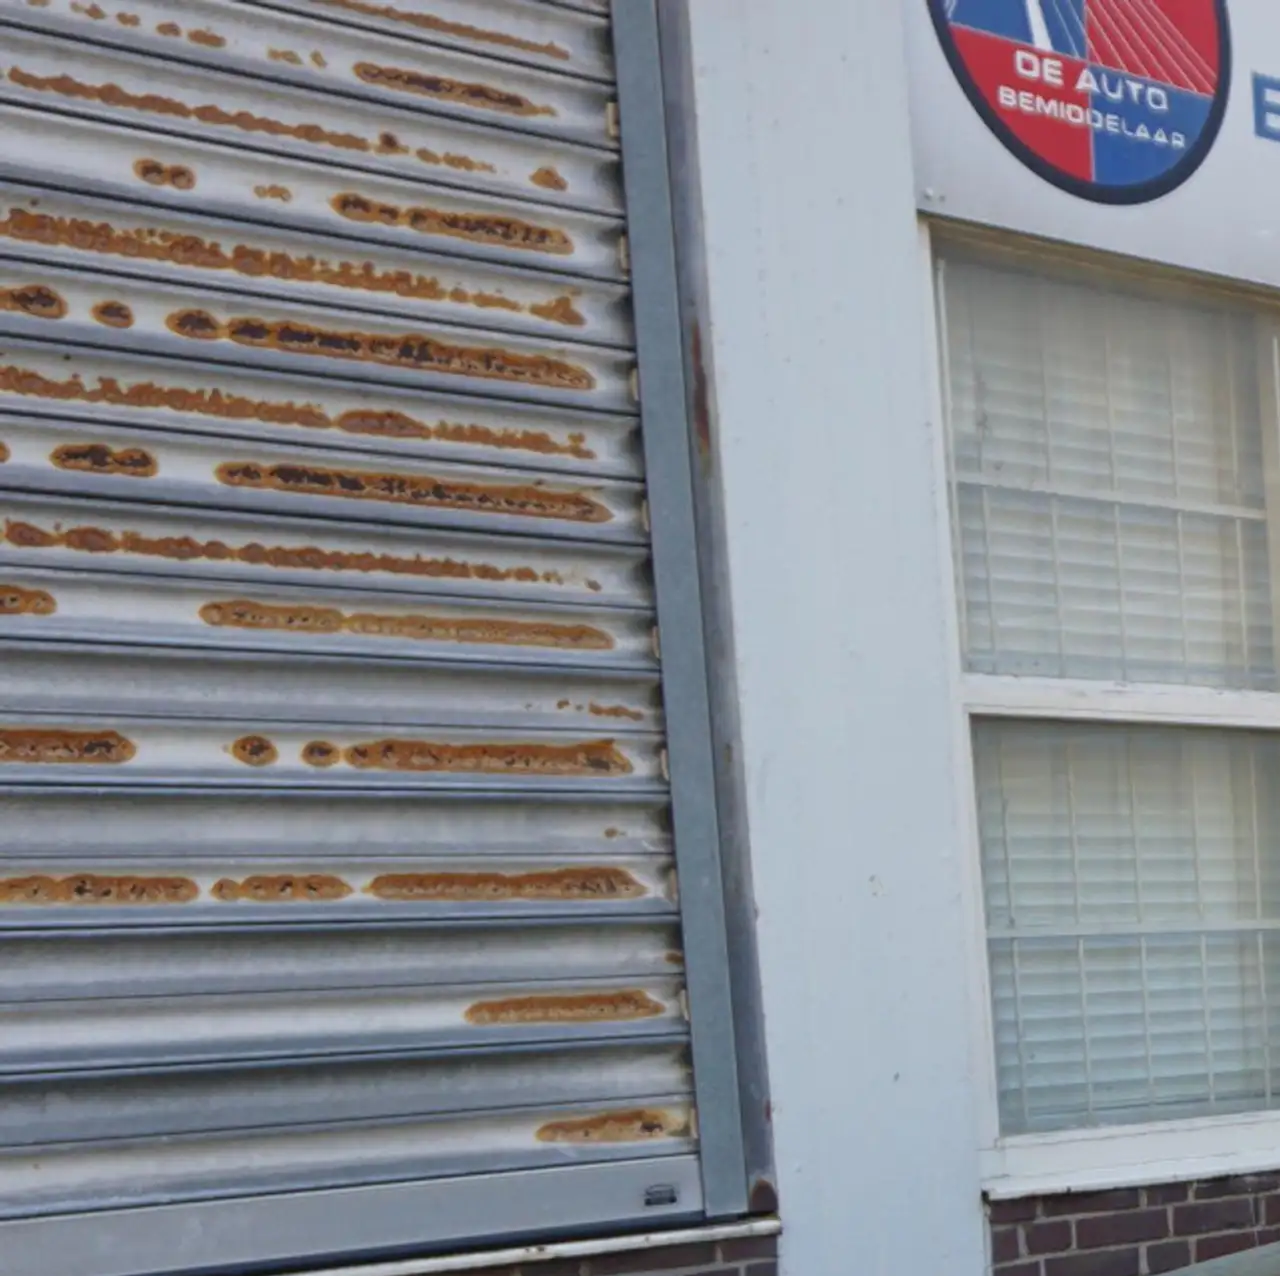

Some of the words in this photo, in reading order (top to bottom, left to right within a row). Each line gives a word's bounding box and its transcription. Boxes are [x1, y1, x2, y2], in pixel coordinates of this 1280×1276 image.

[1014, 49, 1064, 86] DE
[1075, 67, 1169, 111] AUTO
[997, 84, 1186, 149] BEMIDDELAAR
